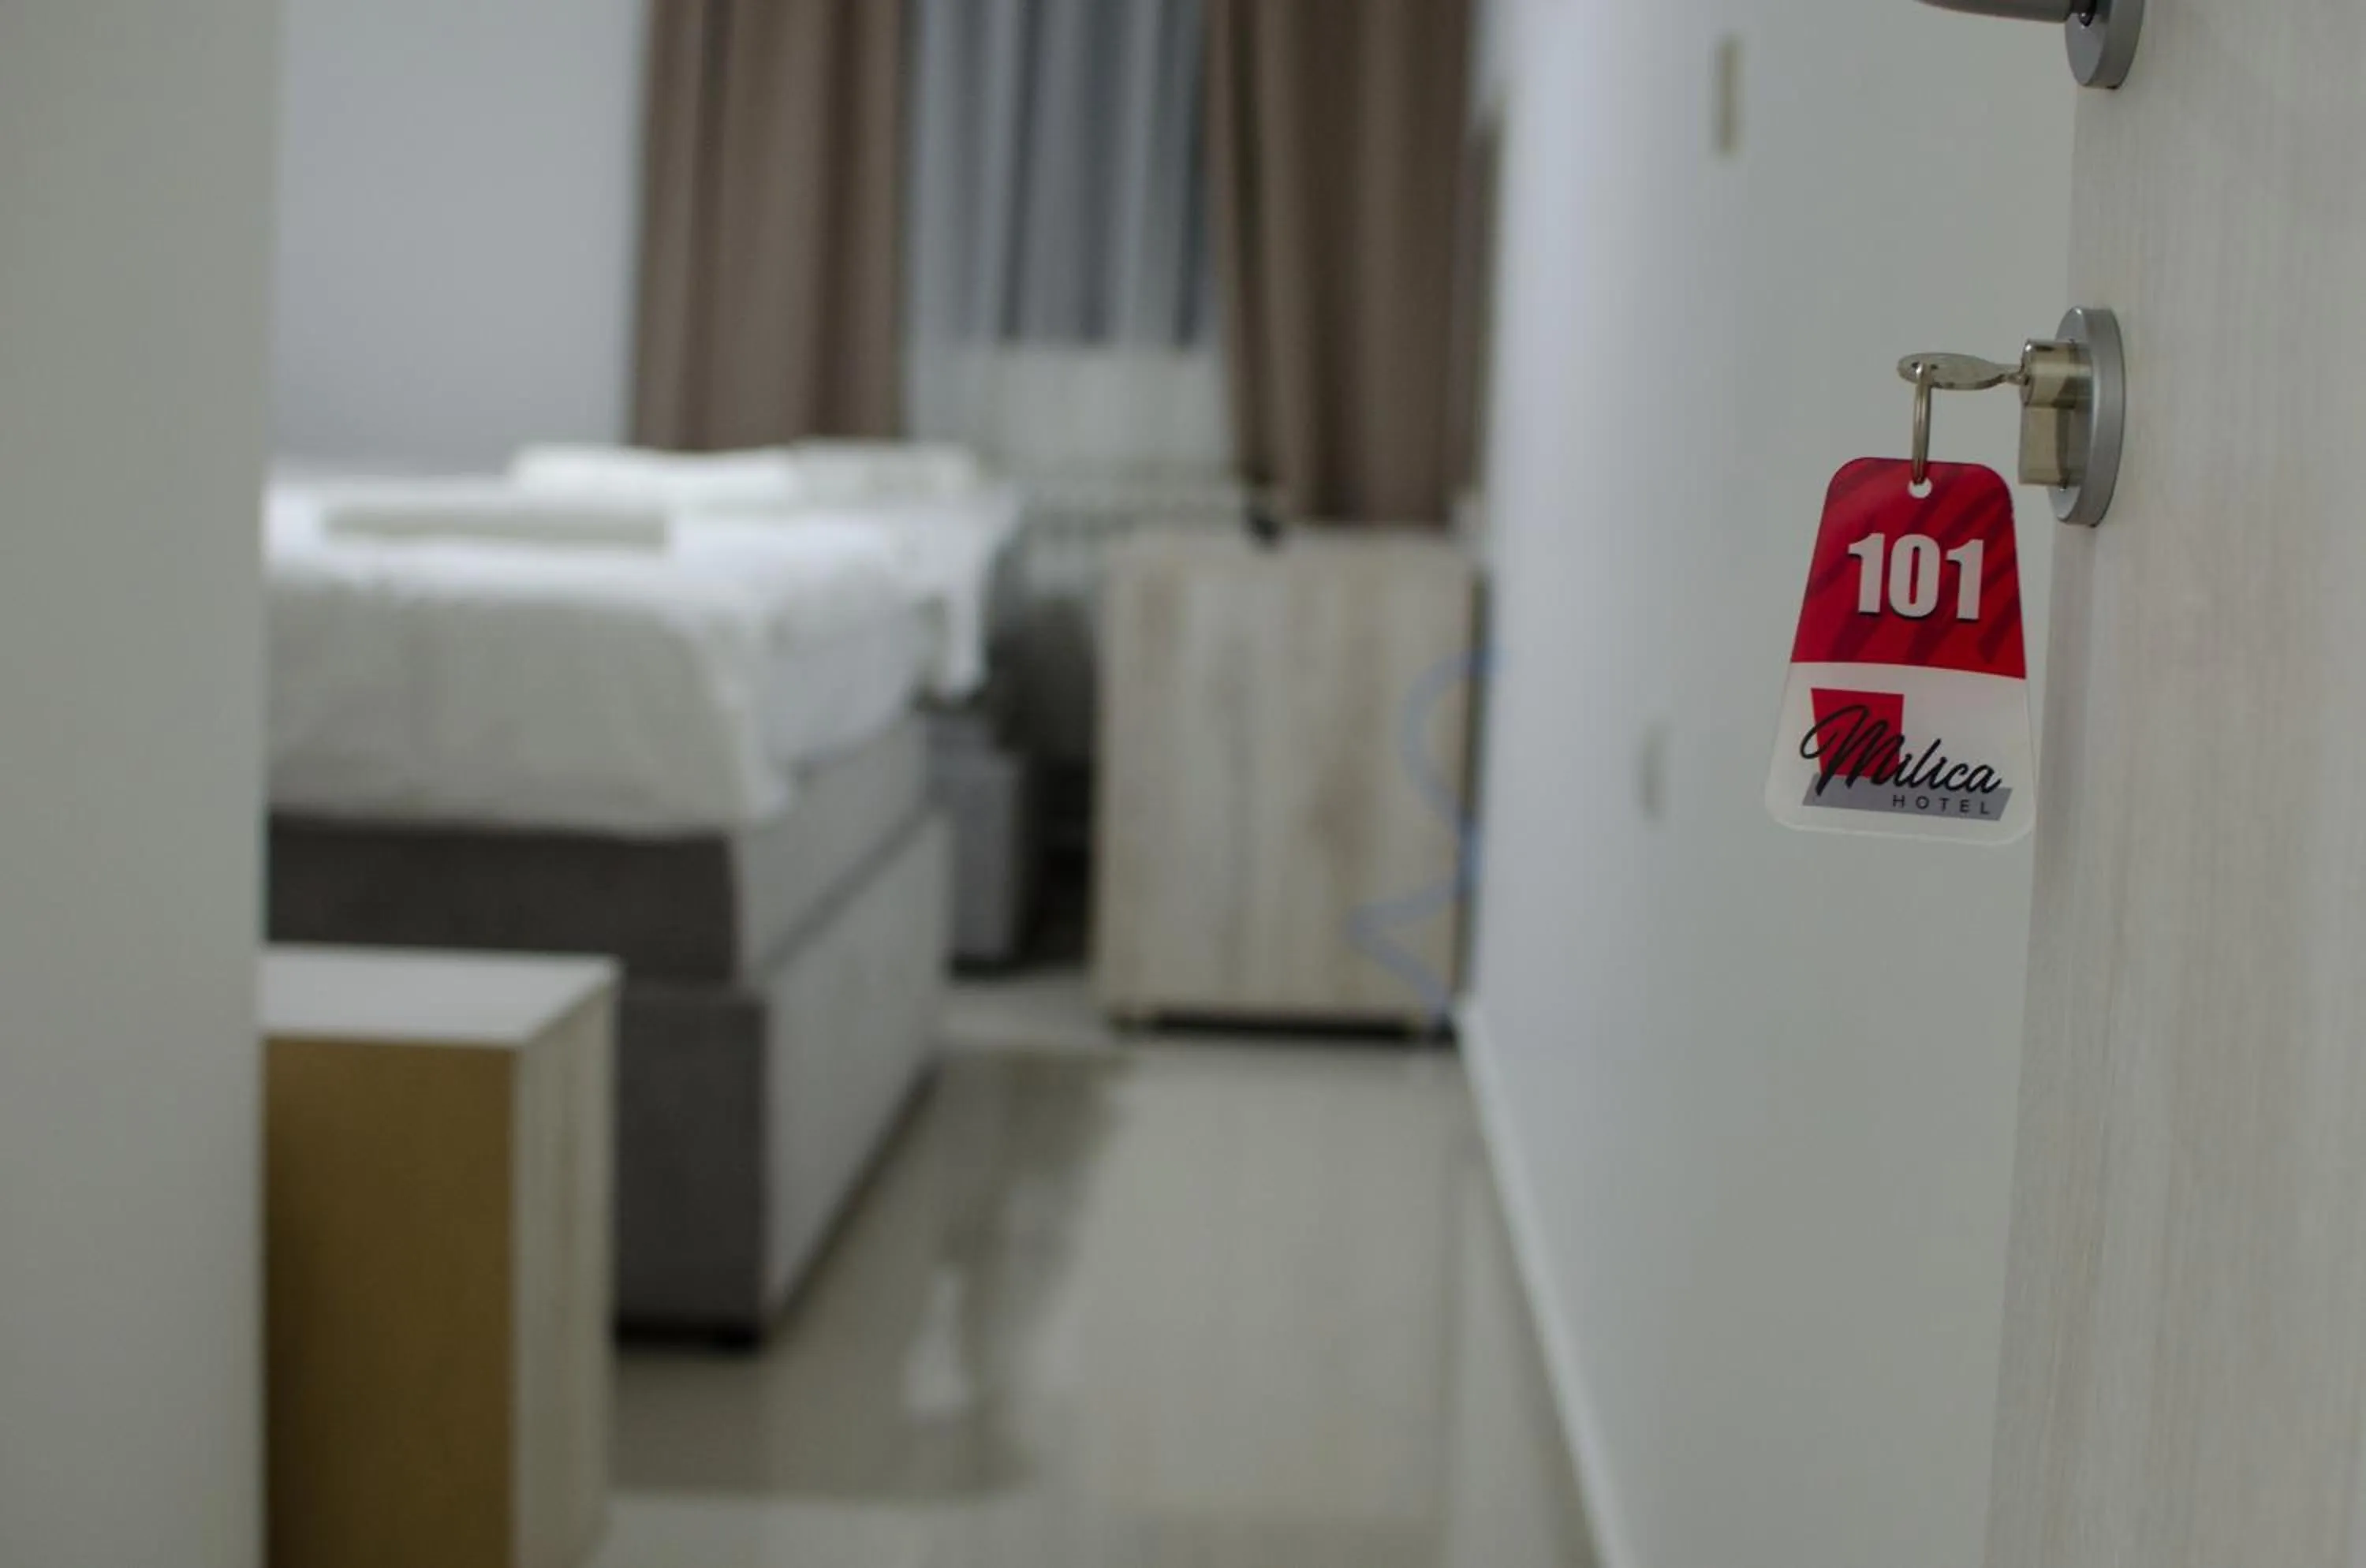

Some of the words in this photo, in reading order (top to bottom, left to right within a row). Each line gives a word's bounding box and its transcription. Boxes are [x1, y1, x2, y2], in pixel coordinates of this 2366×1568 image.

[1848, 532, 1984, 621] 101
[1800, 704, 2002, 797] Milica
[1893, 794, 1991, 815] HOTEL
